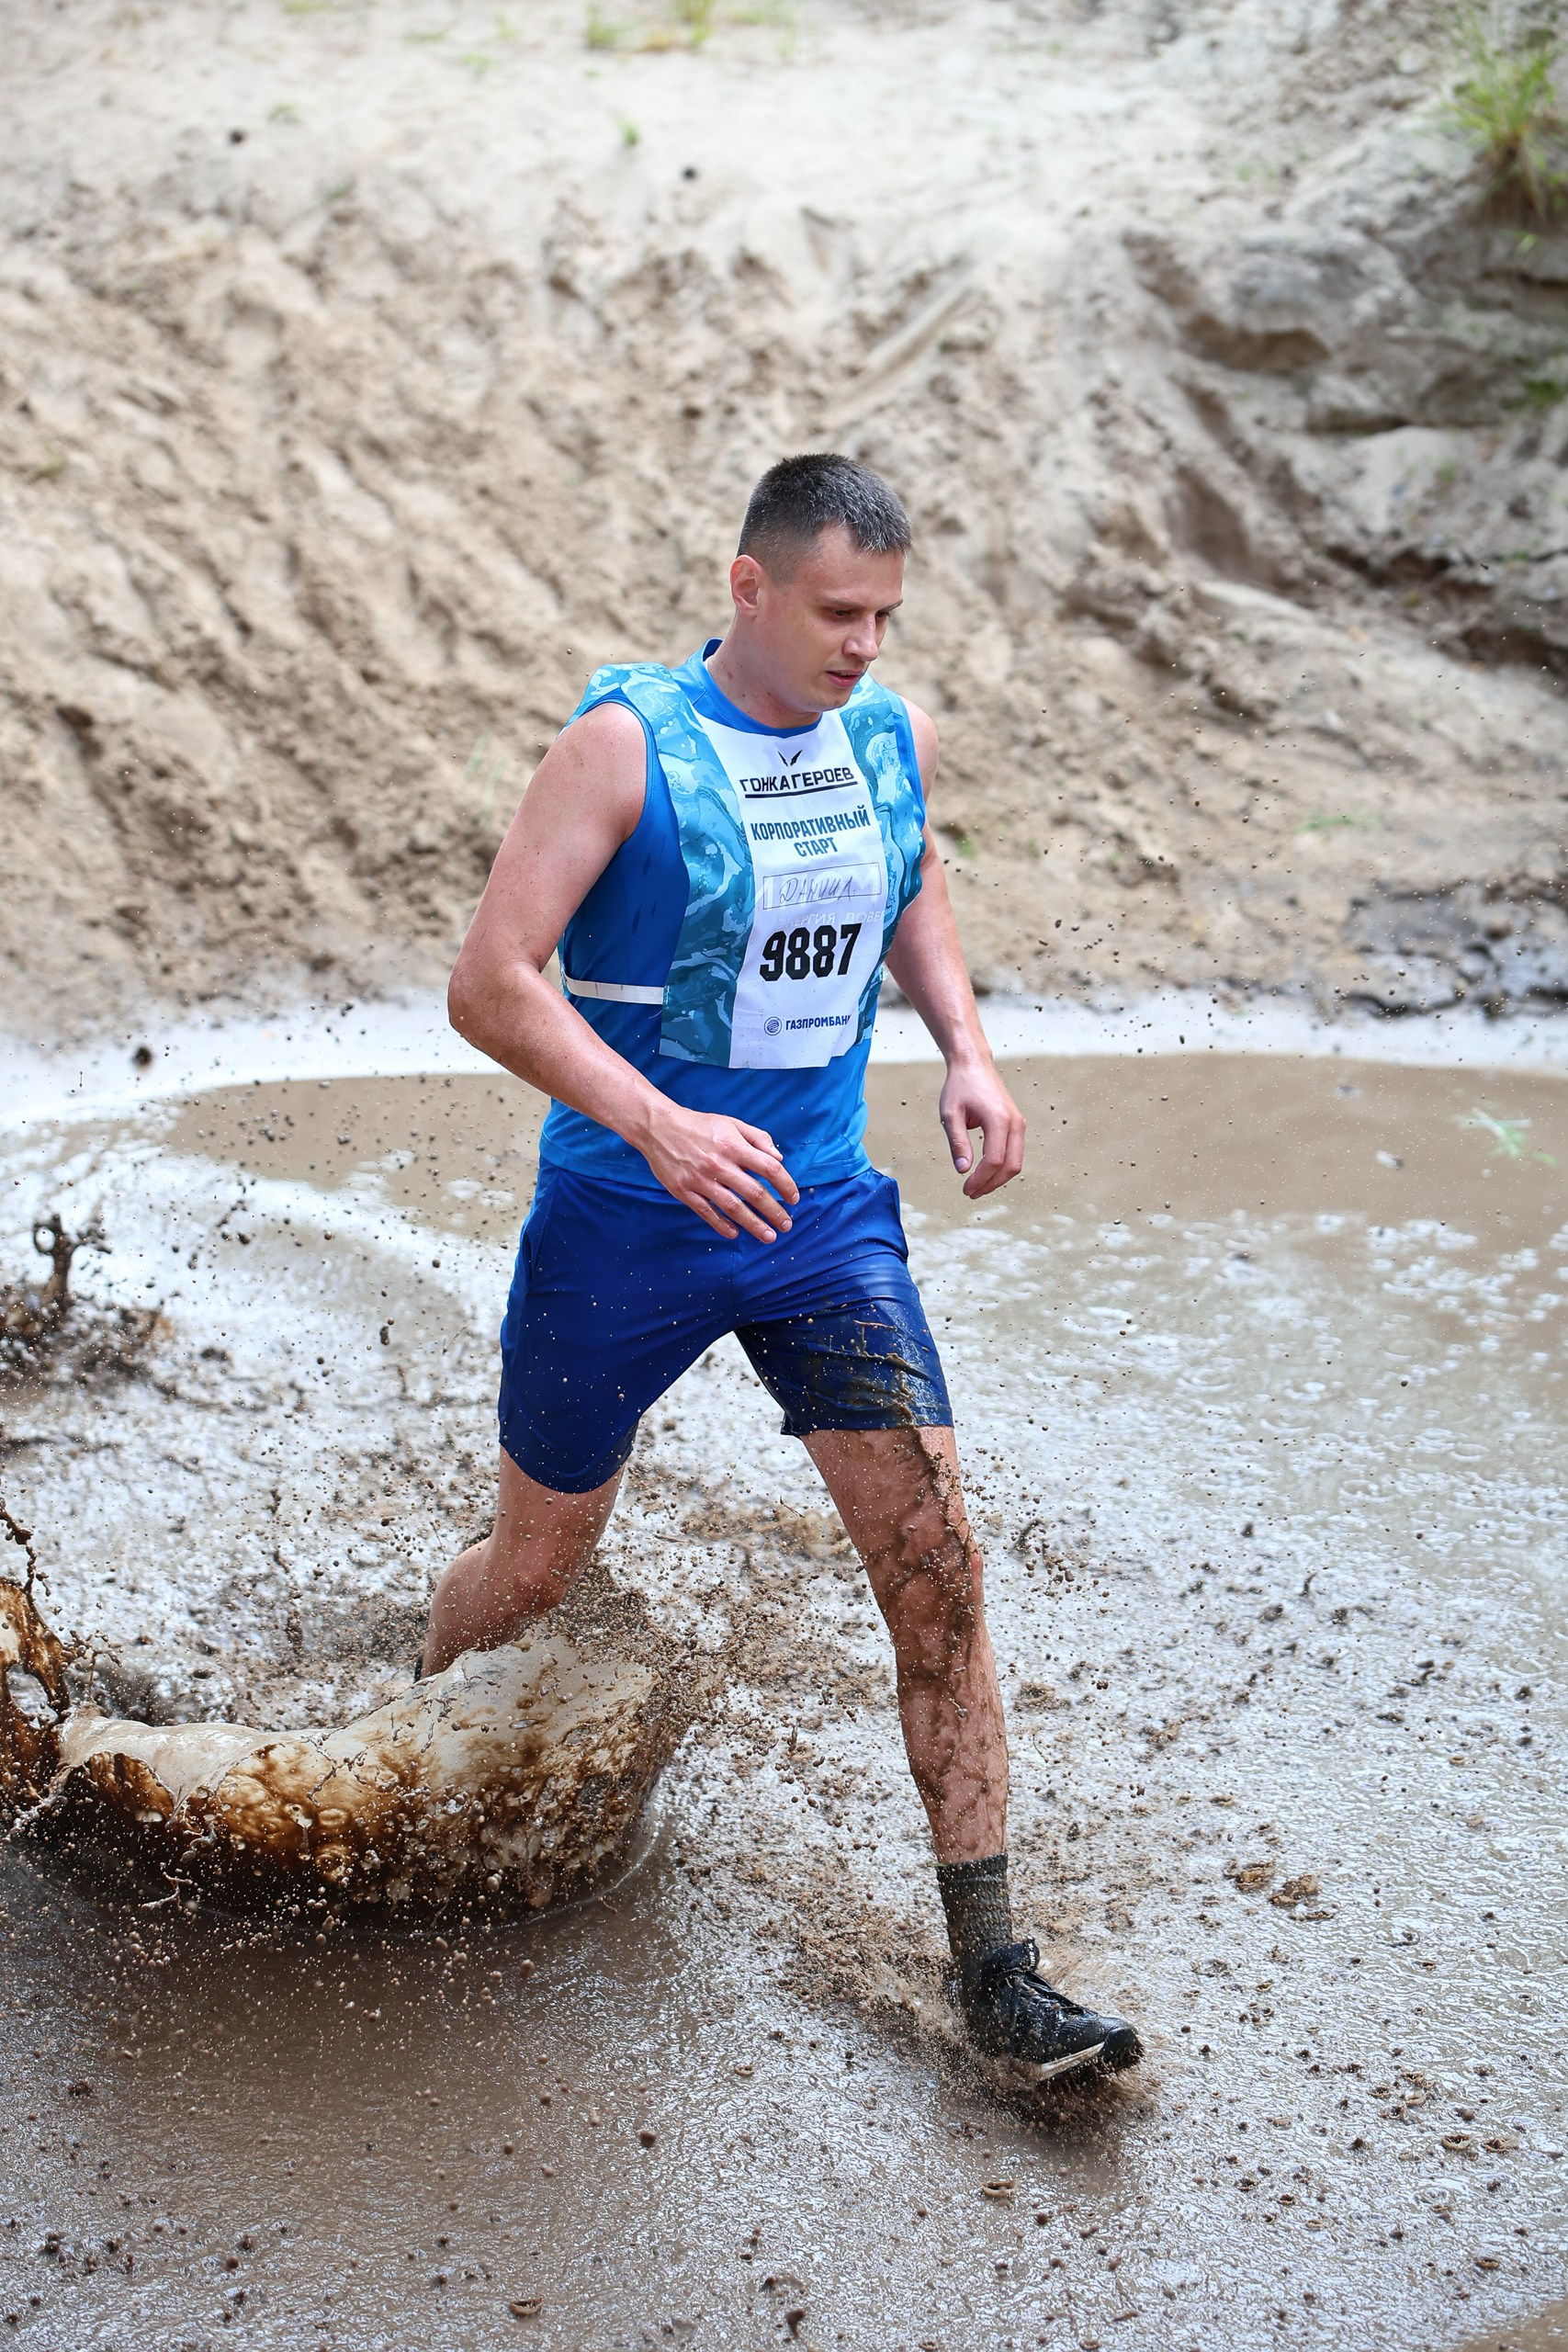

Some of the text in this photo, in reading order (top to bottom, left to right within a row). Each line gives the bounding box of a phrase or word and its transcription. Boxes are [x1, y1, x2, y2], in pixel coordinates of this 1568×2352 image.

[750, 804, 871, 841] КОРПОРАТИВНЫЙ
[794, 837, 839, 857] СТАРТ
[760, 922, 862, 981] 9887
